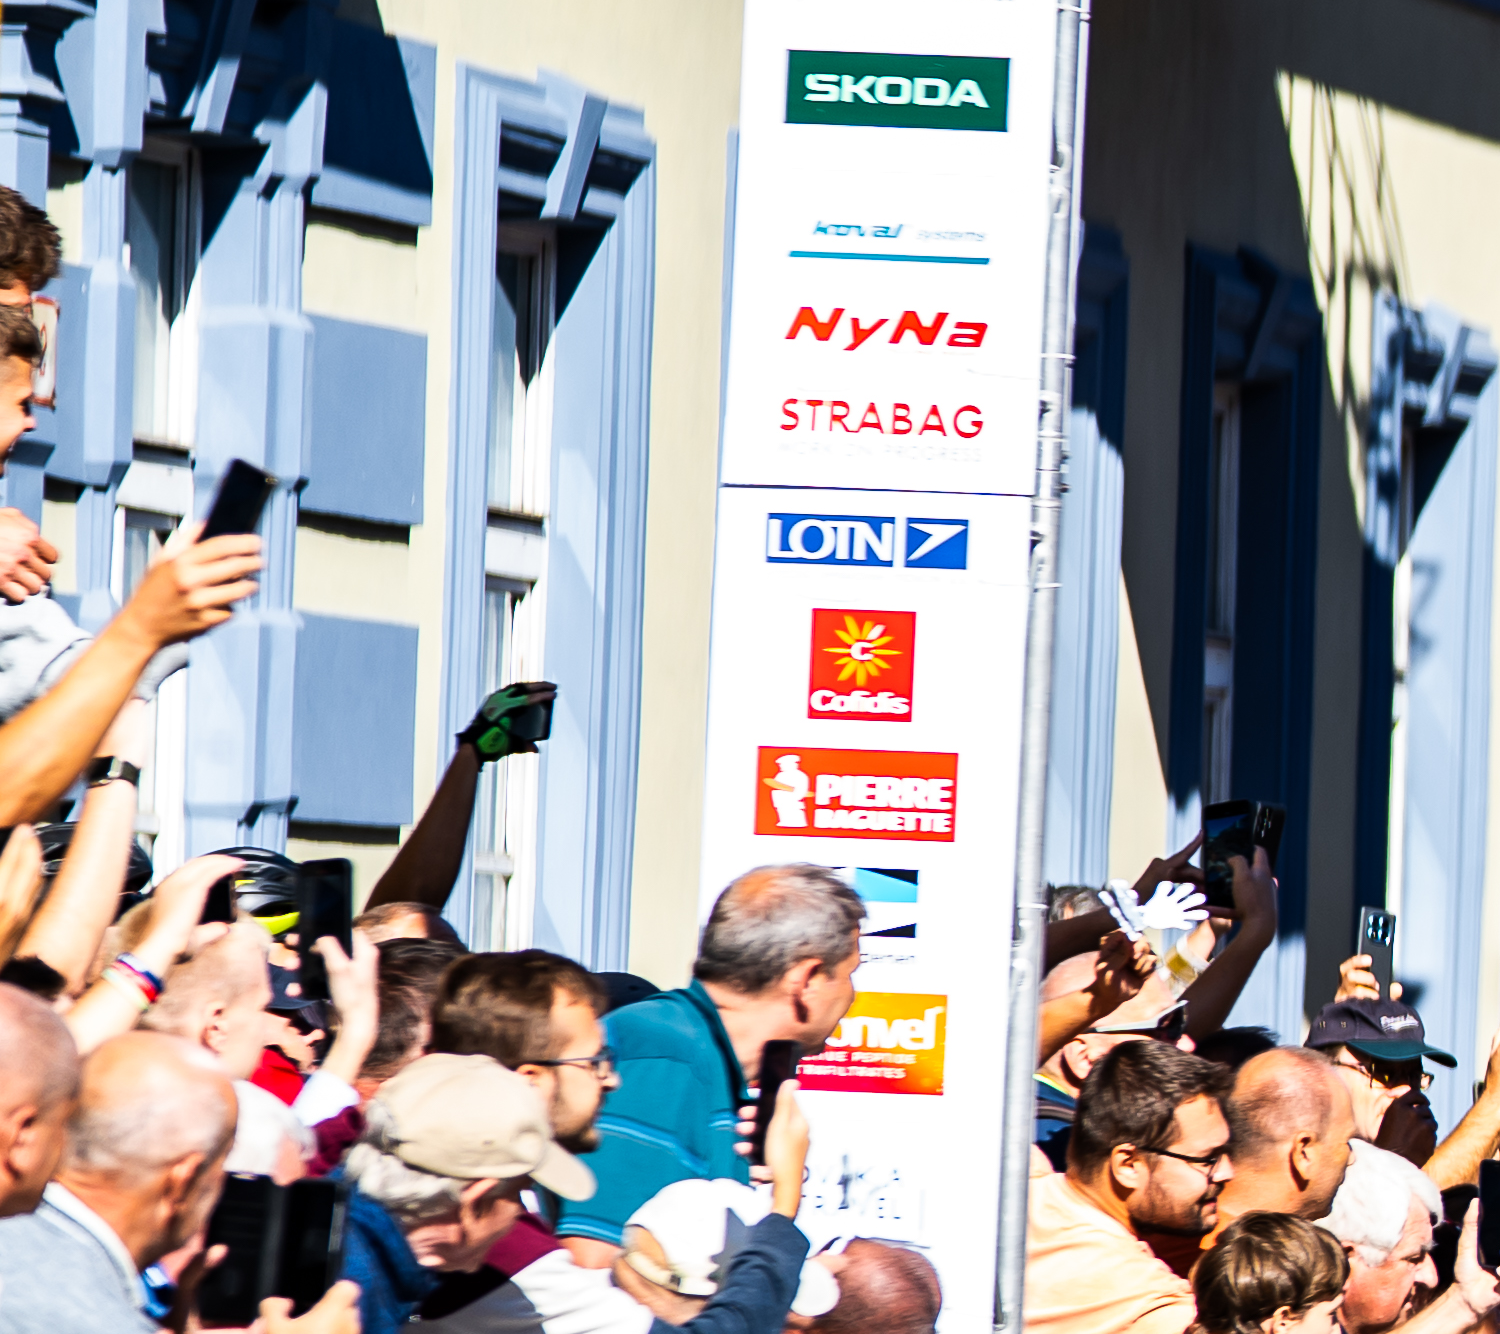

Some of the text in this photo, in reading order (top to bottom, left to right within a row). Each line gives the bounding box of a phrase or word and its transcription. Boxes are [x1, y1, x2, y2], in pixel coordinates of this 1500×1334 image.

[785, 306, 987, 351] NyNa
[780, 399, 984, 439] STRABAG
[767, 518, 894, 561] LOTN
[810, 690, 909, 716] Cofidis
[814, 774, 953, 811] PIERRE
[813, 809, 952, 834] BAGUETTE
